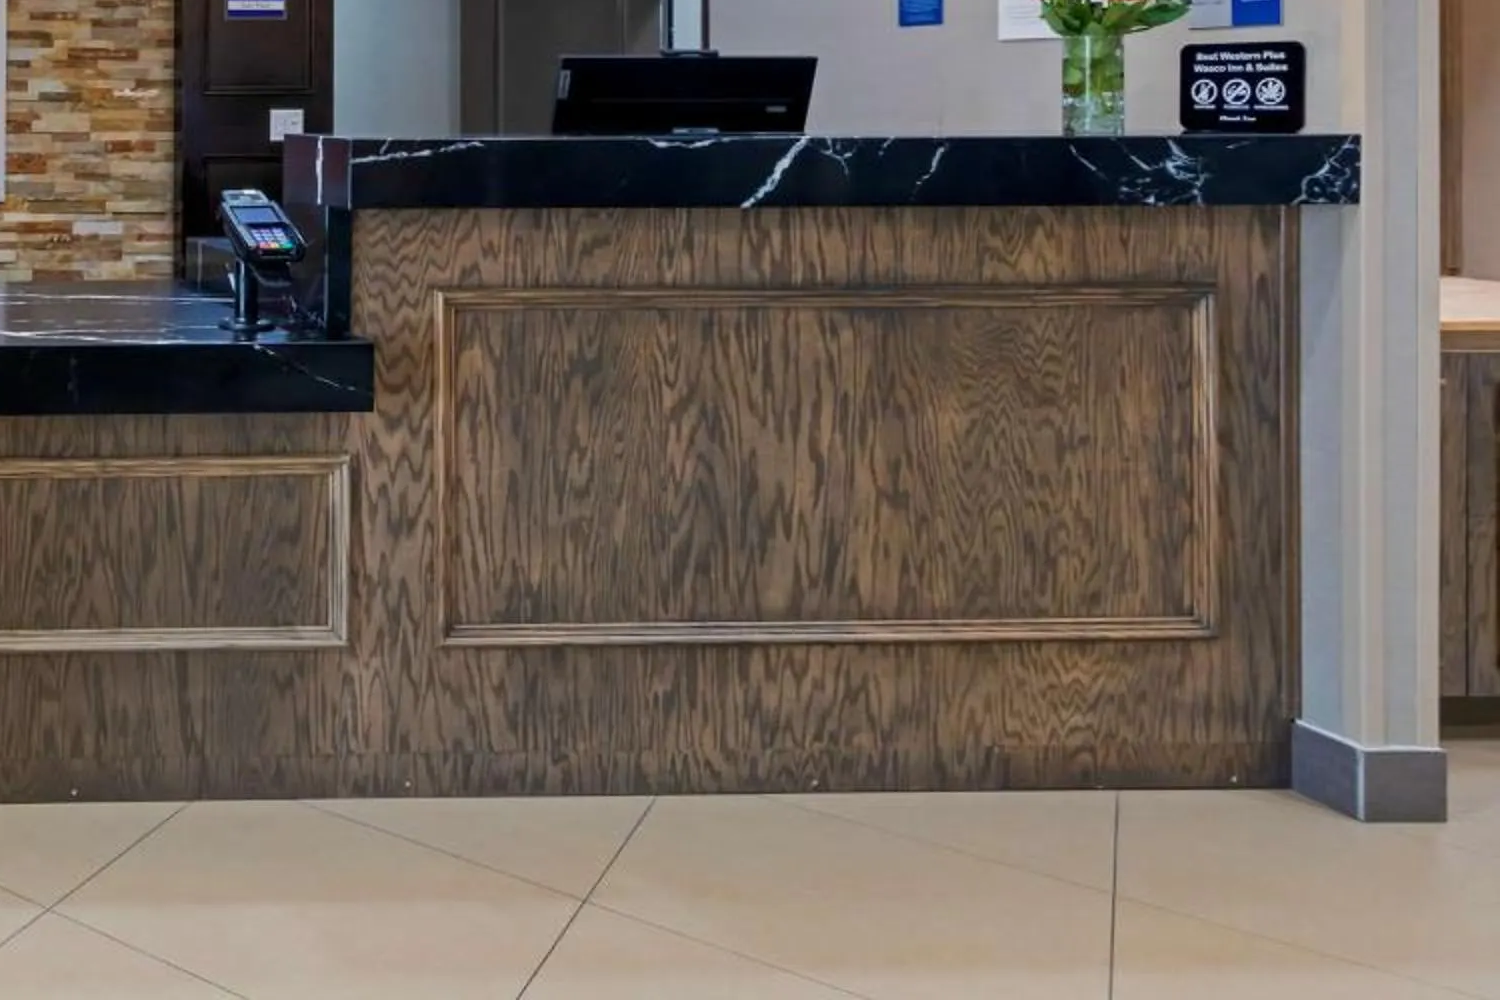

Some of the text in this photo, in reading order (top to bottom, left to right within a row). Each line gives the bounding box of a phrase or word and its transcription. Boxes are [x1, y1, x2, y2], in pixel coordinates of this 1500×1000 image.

[1196, 50, 1286, 61] Best Western Plus
[1245, 63, 1254, 72] &
[1255, 62, 1288, 72] Suites
